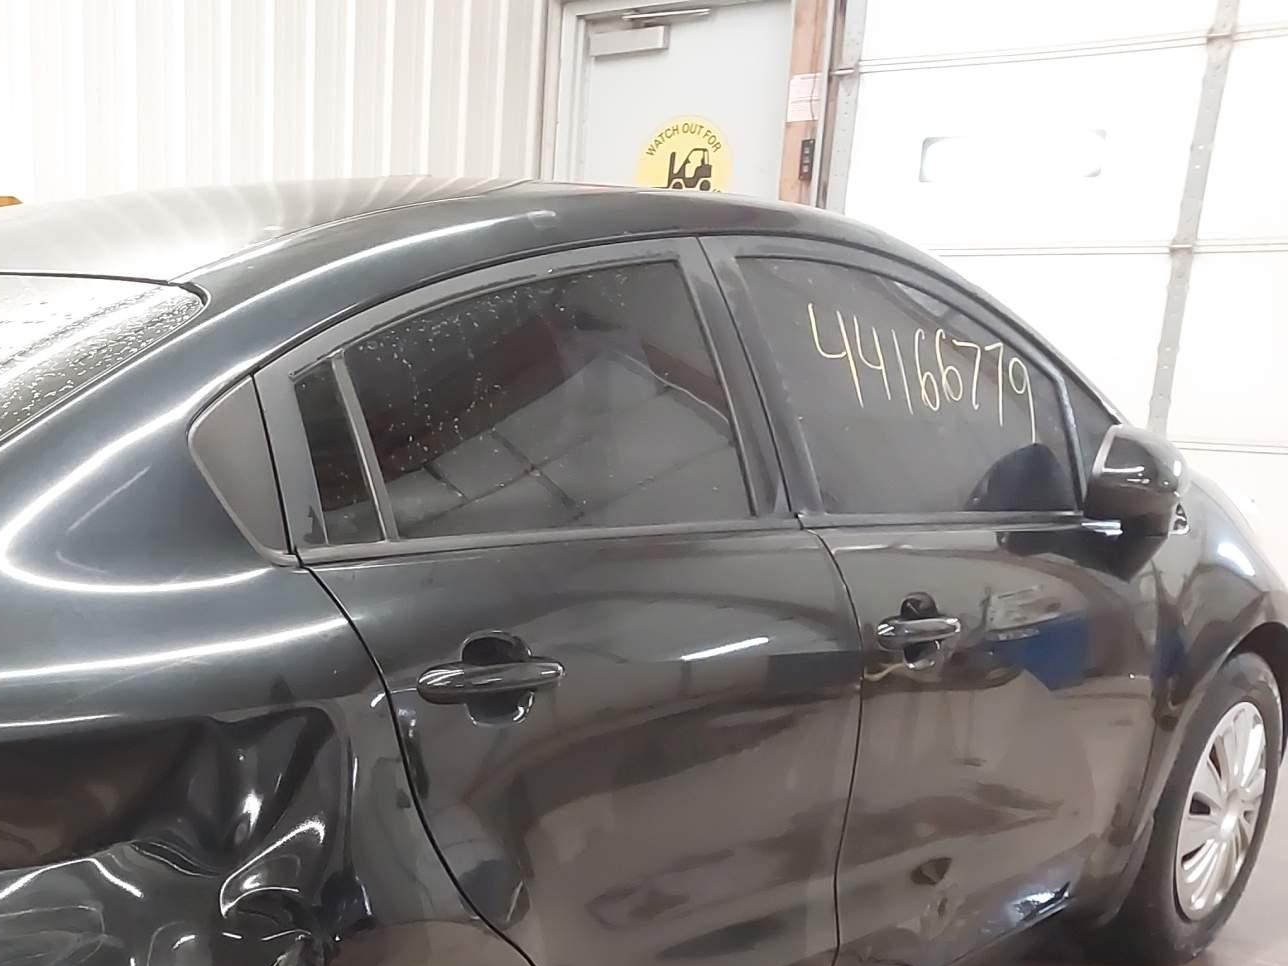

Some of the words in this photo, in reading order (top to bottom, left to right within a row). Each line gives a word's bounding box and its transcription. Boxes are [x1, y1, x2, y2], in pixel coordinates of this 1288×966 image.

[646, 124, 679, 156] WATCH
[682, 122, 705, 135] OUT
[702, 129, 722, 153] FOR
[807, 302, 1036, 444] 44166779
